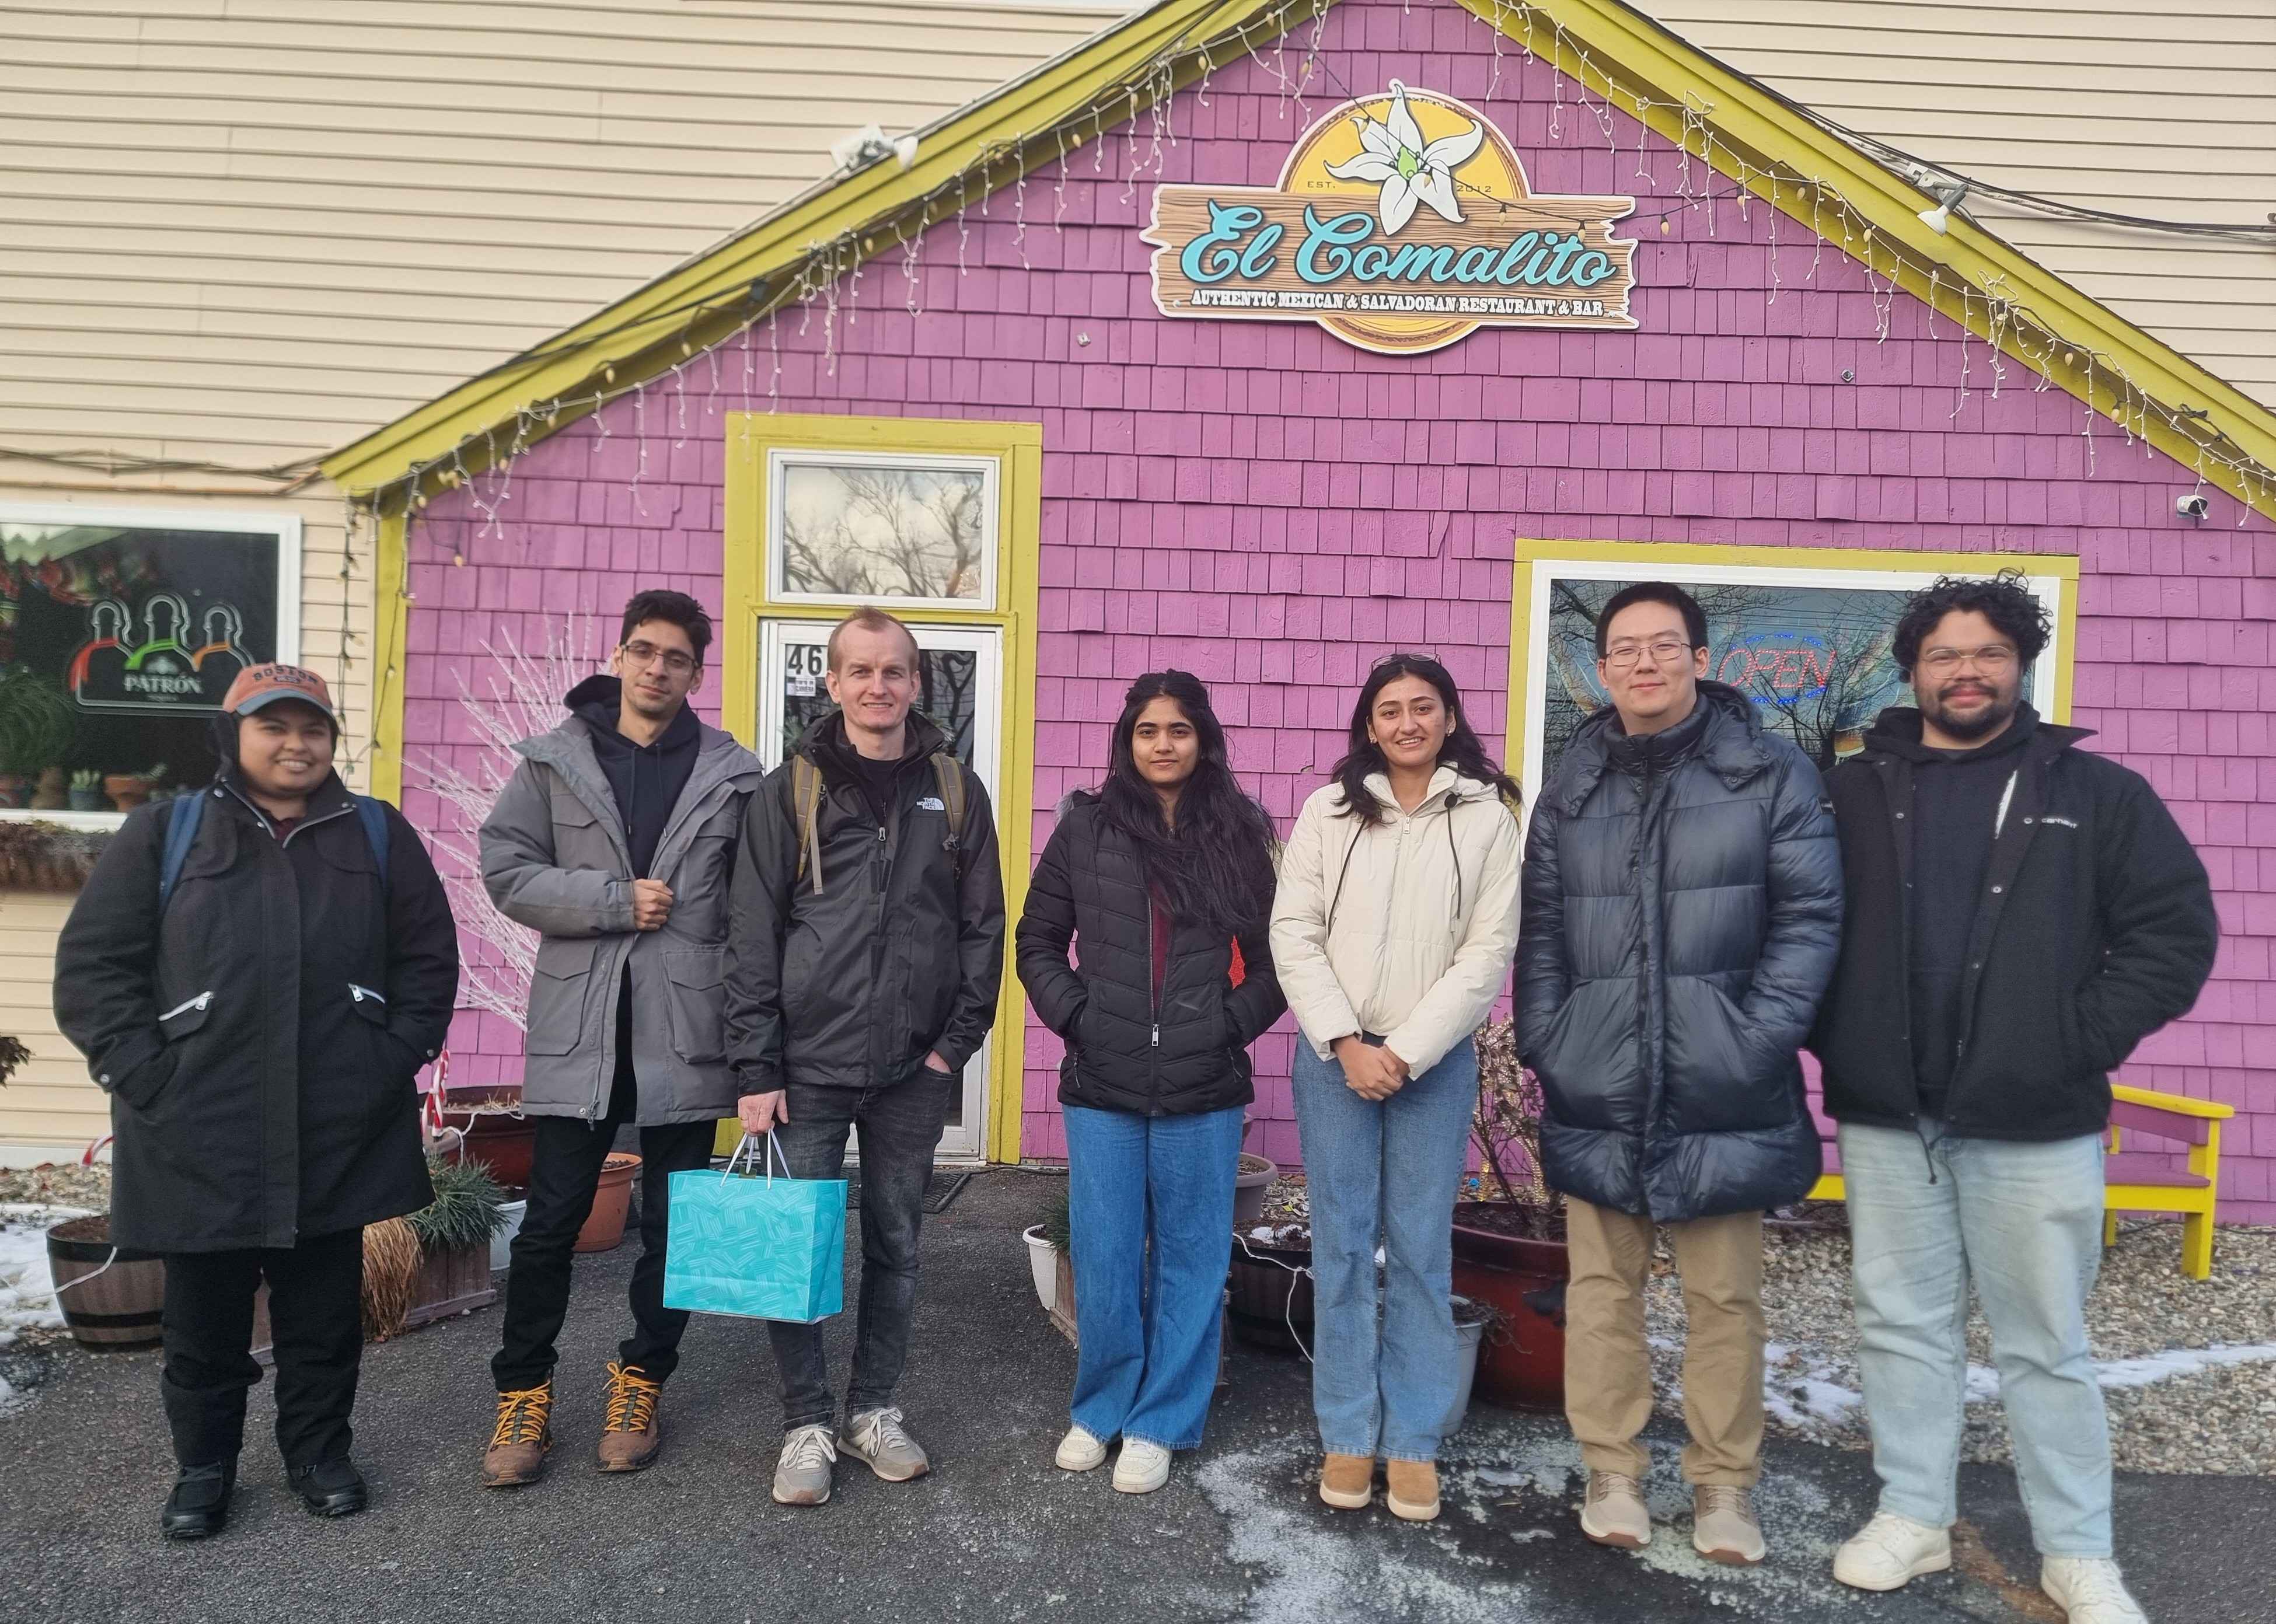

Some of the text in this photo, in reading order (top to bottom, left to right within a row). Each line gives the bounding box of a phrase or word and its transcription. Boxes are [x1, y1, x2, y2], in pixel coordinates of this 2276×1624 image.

[1307, 180, 1492, 193] EST. 2012
[1181, 199, 1616, 287] El Comalito
[1191, 289, 1604, 316] AUTHENTIC MEXICAN & SALVADORAN RESTAURANT & BAR
[787, 645, 822, 676] 46
[1716, 648, 1837, 689] OPEN
